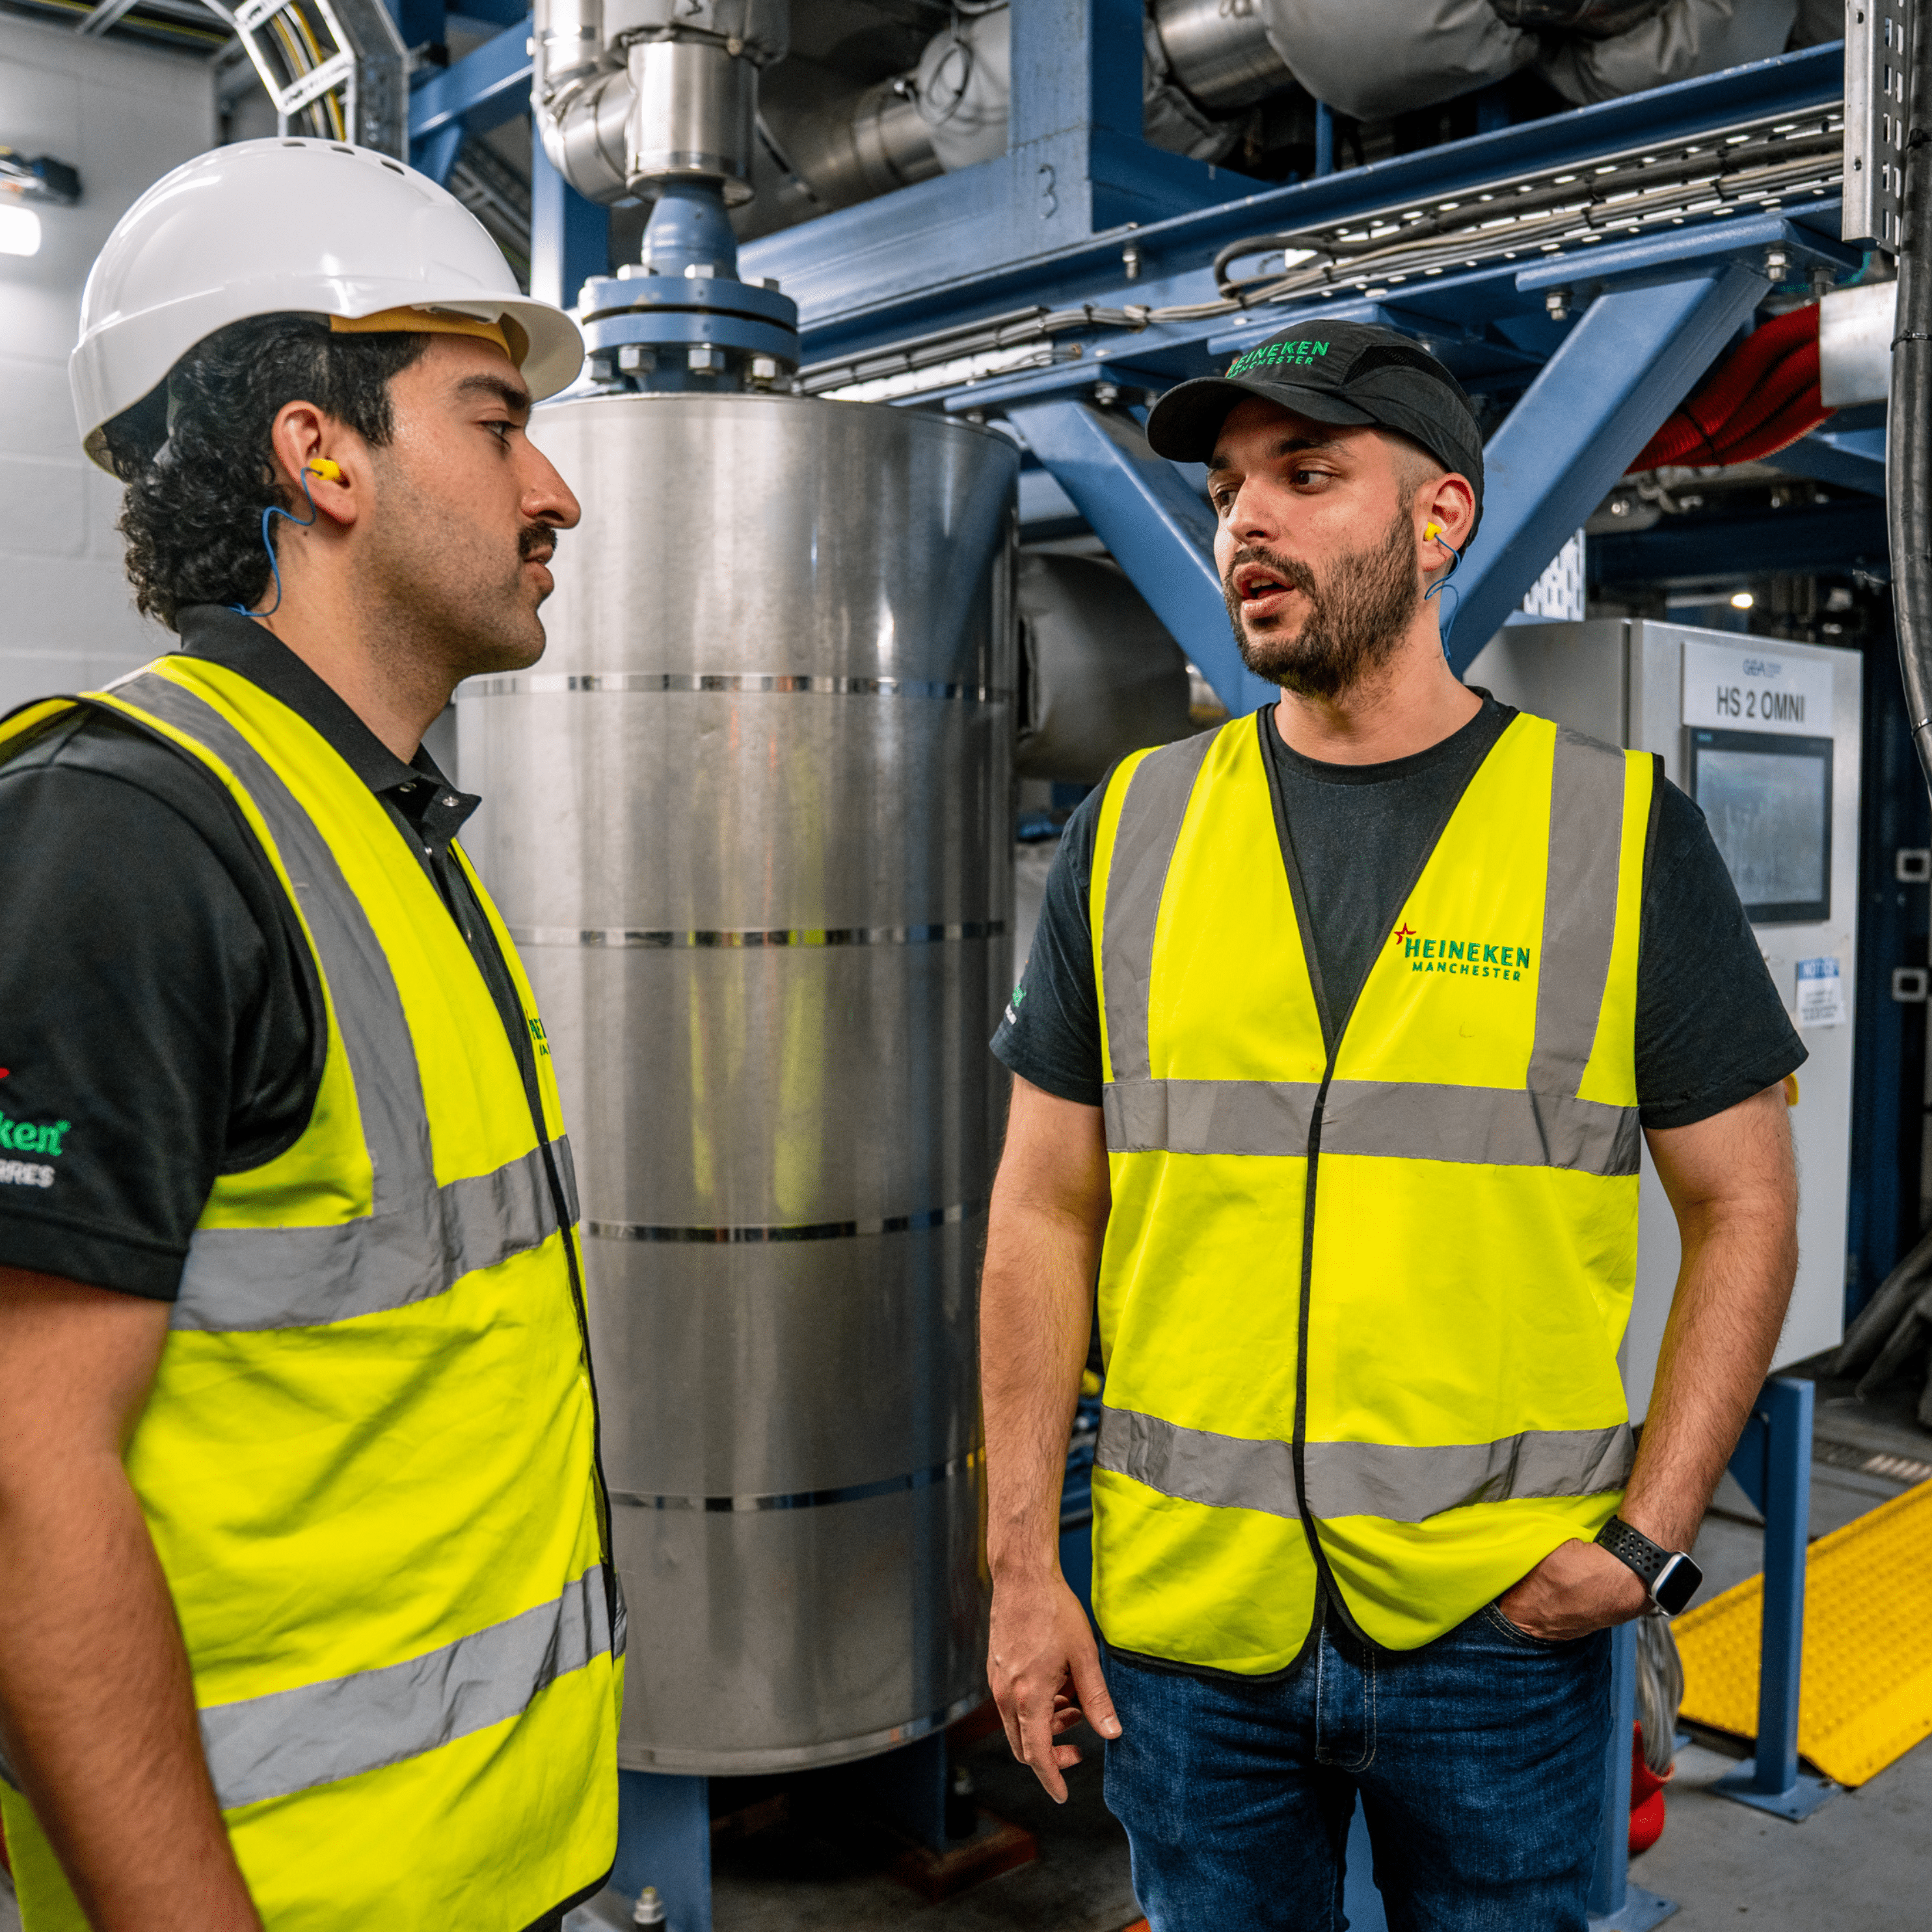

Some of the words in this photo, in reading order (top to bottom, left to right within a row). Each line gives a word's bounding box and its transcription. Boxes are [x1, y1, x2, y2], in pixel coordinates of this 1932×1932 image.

[1226, 340, 1330, 376] HEINEKEN
[1717, 685, 1741, 718] HS
[1746, 689, 1756, 719] 2
[1760, 691, 1805, 723] OMNI
[1405, 937, 1530, 969] HEINEKEN
[1412, 961, 1521, 982] MANCHESTER
